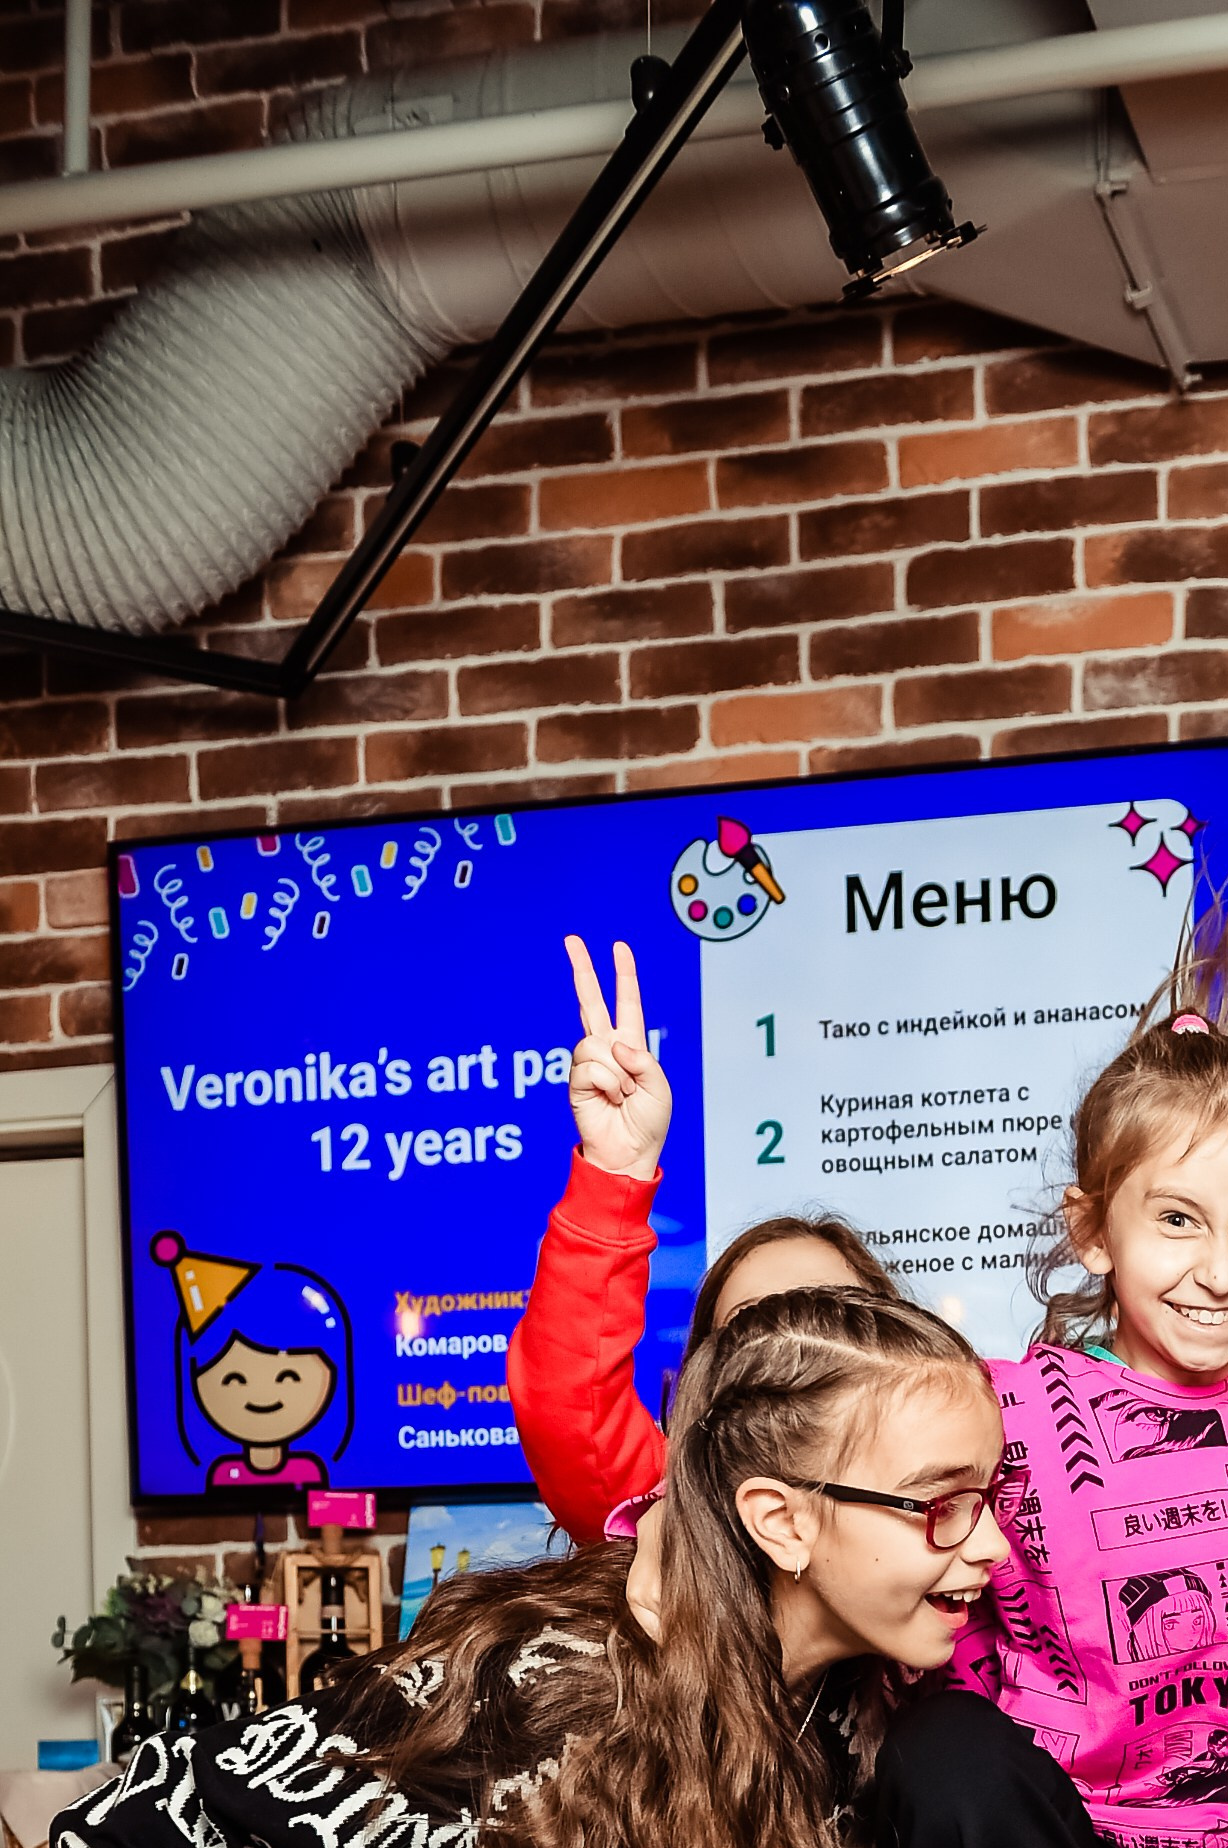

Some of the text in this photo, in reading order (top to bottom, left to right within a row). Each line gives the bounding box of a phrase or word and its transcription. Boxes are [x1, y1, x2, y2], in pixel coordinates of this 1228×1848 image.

[846, 870, 1057, 934] Меню
[755, 1014, 775, 1057] 1
[819, 1002, 1146, 1040] Тако с индейкой и ананасом
[427, 1044, 499, 1094] art
[820, 1086, 1029, 1118] Куриная котлета с
[756, 1119, 785, 1165] 2
[821, 1115, 1063, 1144] картофельным пюре
[311, 1123, 523, 1182] 12 years
[821, 1147, 1037, 1174] овощным салатом
[857, 1225, 970, 1246] льянское
[962, 1256, 973, 1271] с
[398, 1424, 521, 1450] Санькова
